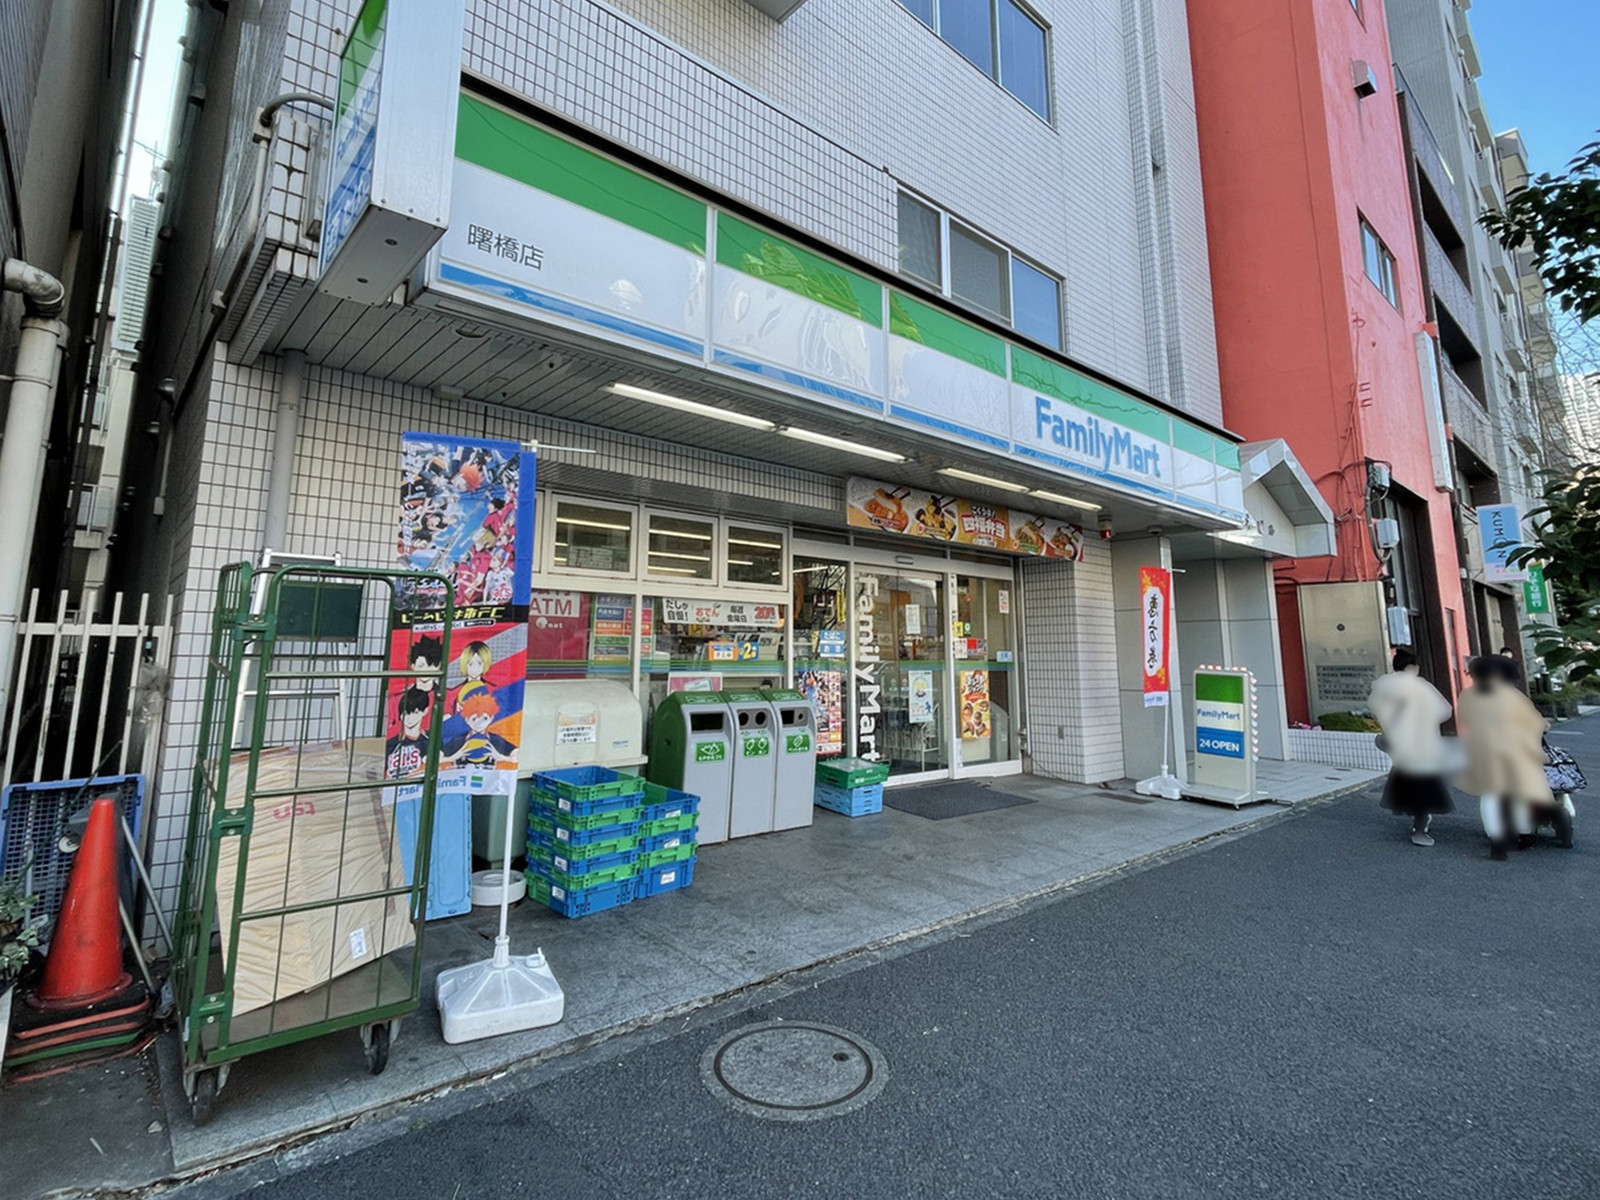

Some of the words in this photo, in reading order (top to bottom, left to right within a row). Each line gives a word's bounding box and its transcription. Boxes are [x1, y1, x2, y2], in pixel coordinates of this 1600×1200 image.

[467, 222, 544, 272] 曙橋店
[1035, 396, 1161, 478] FamilyMart
[530, 597, 572, 616] ATM
[665, 598, 689, 610] だしが
[695, 605, 720, 618] おでん
[854, 576, 882, 763] FamilyMart
[1197, 708, 1241, 722] FamilyMart
